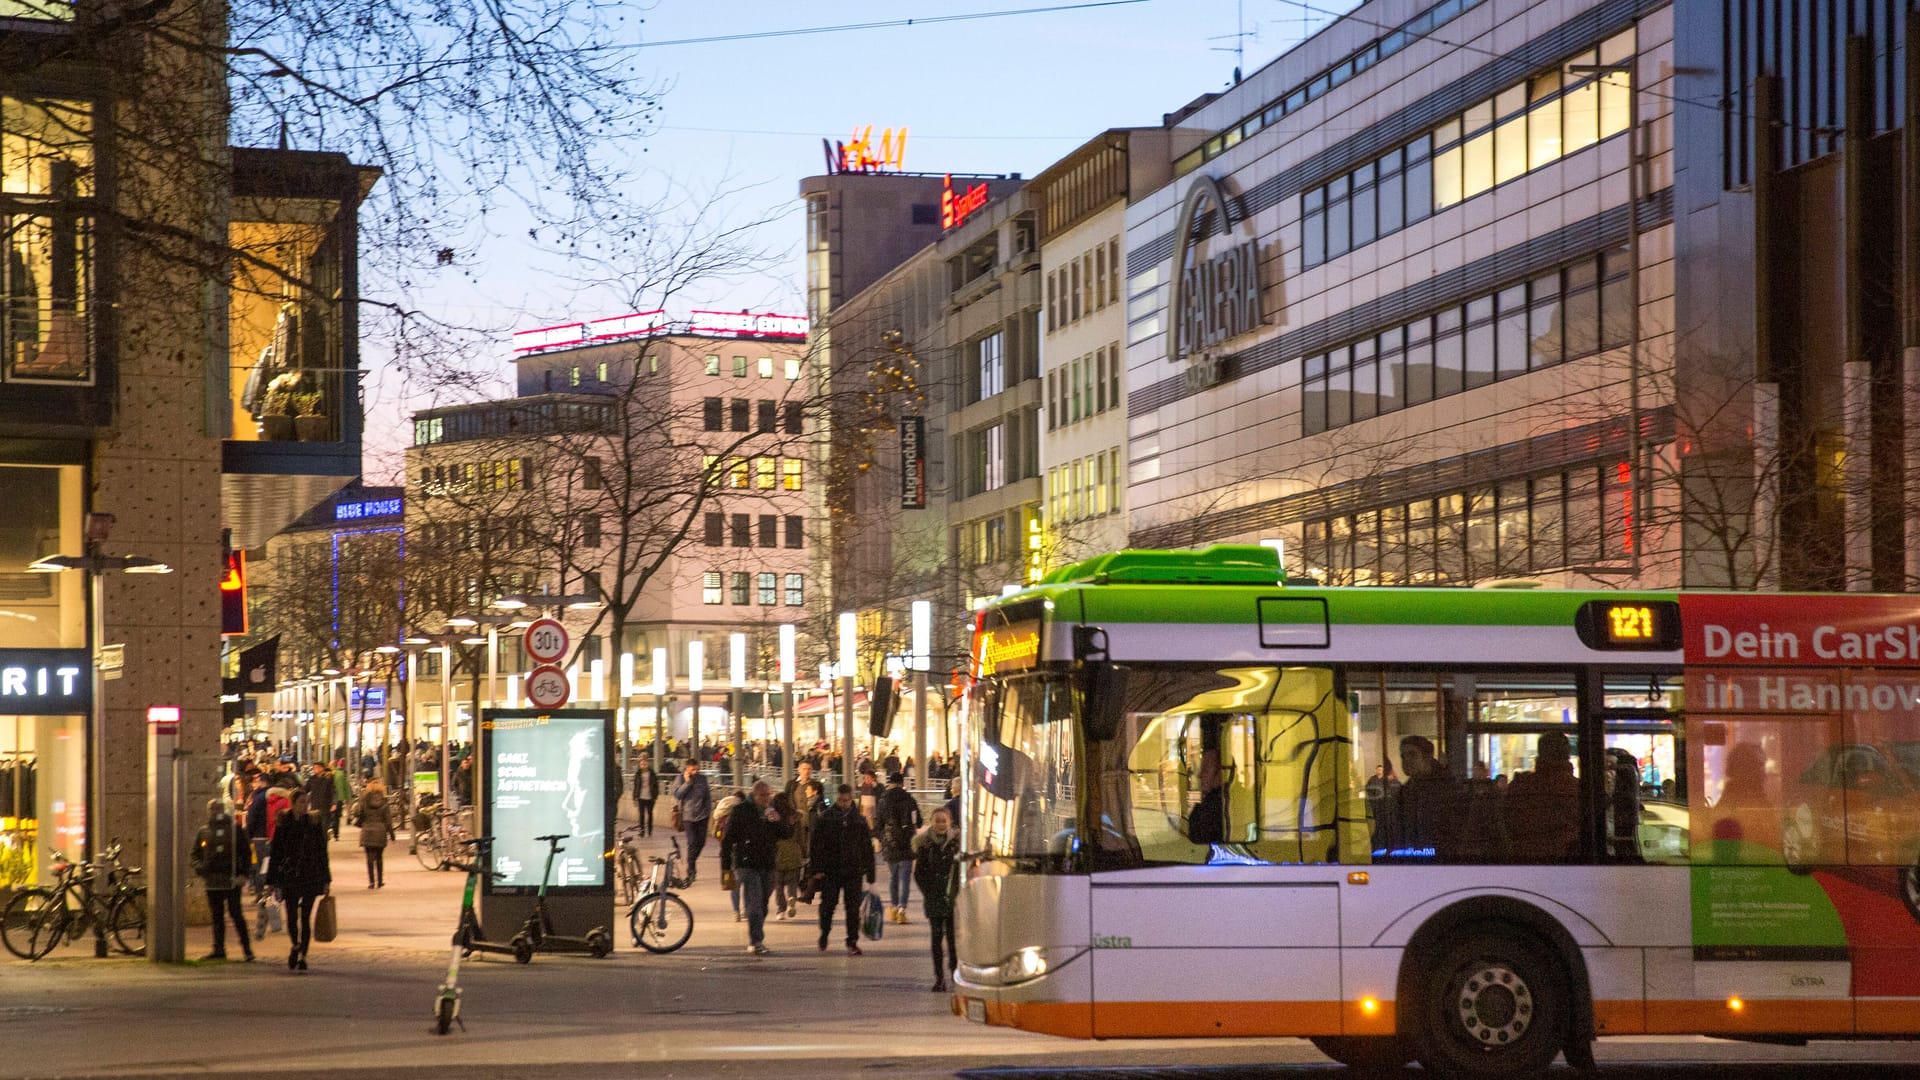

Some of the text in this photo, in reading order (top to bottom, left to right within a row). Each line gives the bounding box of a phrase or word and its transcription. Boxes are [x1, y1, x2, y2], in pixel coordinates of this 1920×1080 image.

[1180, 238, 1261, 356] GALERIA
[903, 420, 917, 505] Hugendubel
[1609, 607, 1652, 637] 121
[1703, 623, 1799, 659] Dein
[1706, 674, 1743, 710] in
